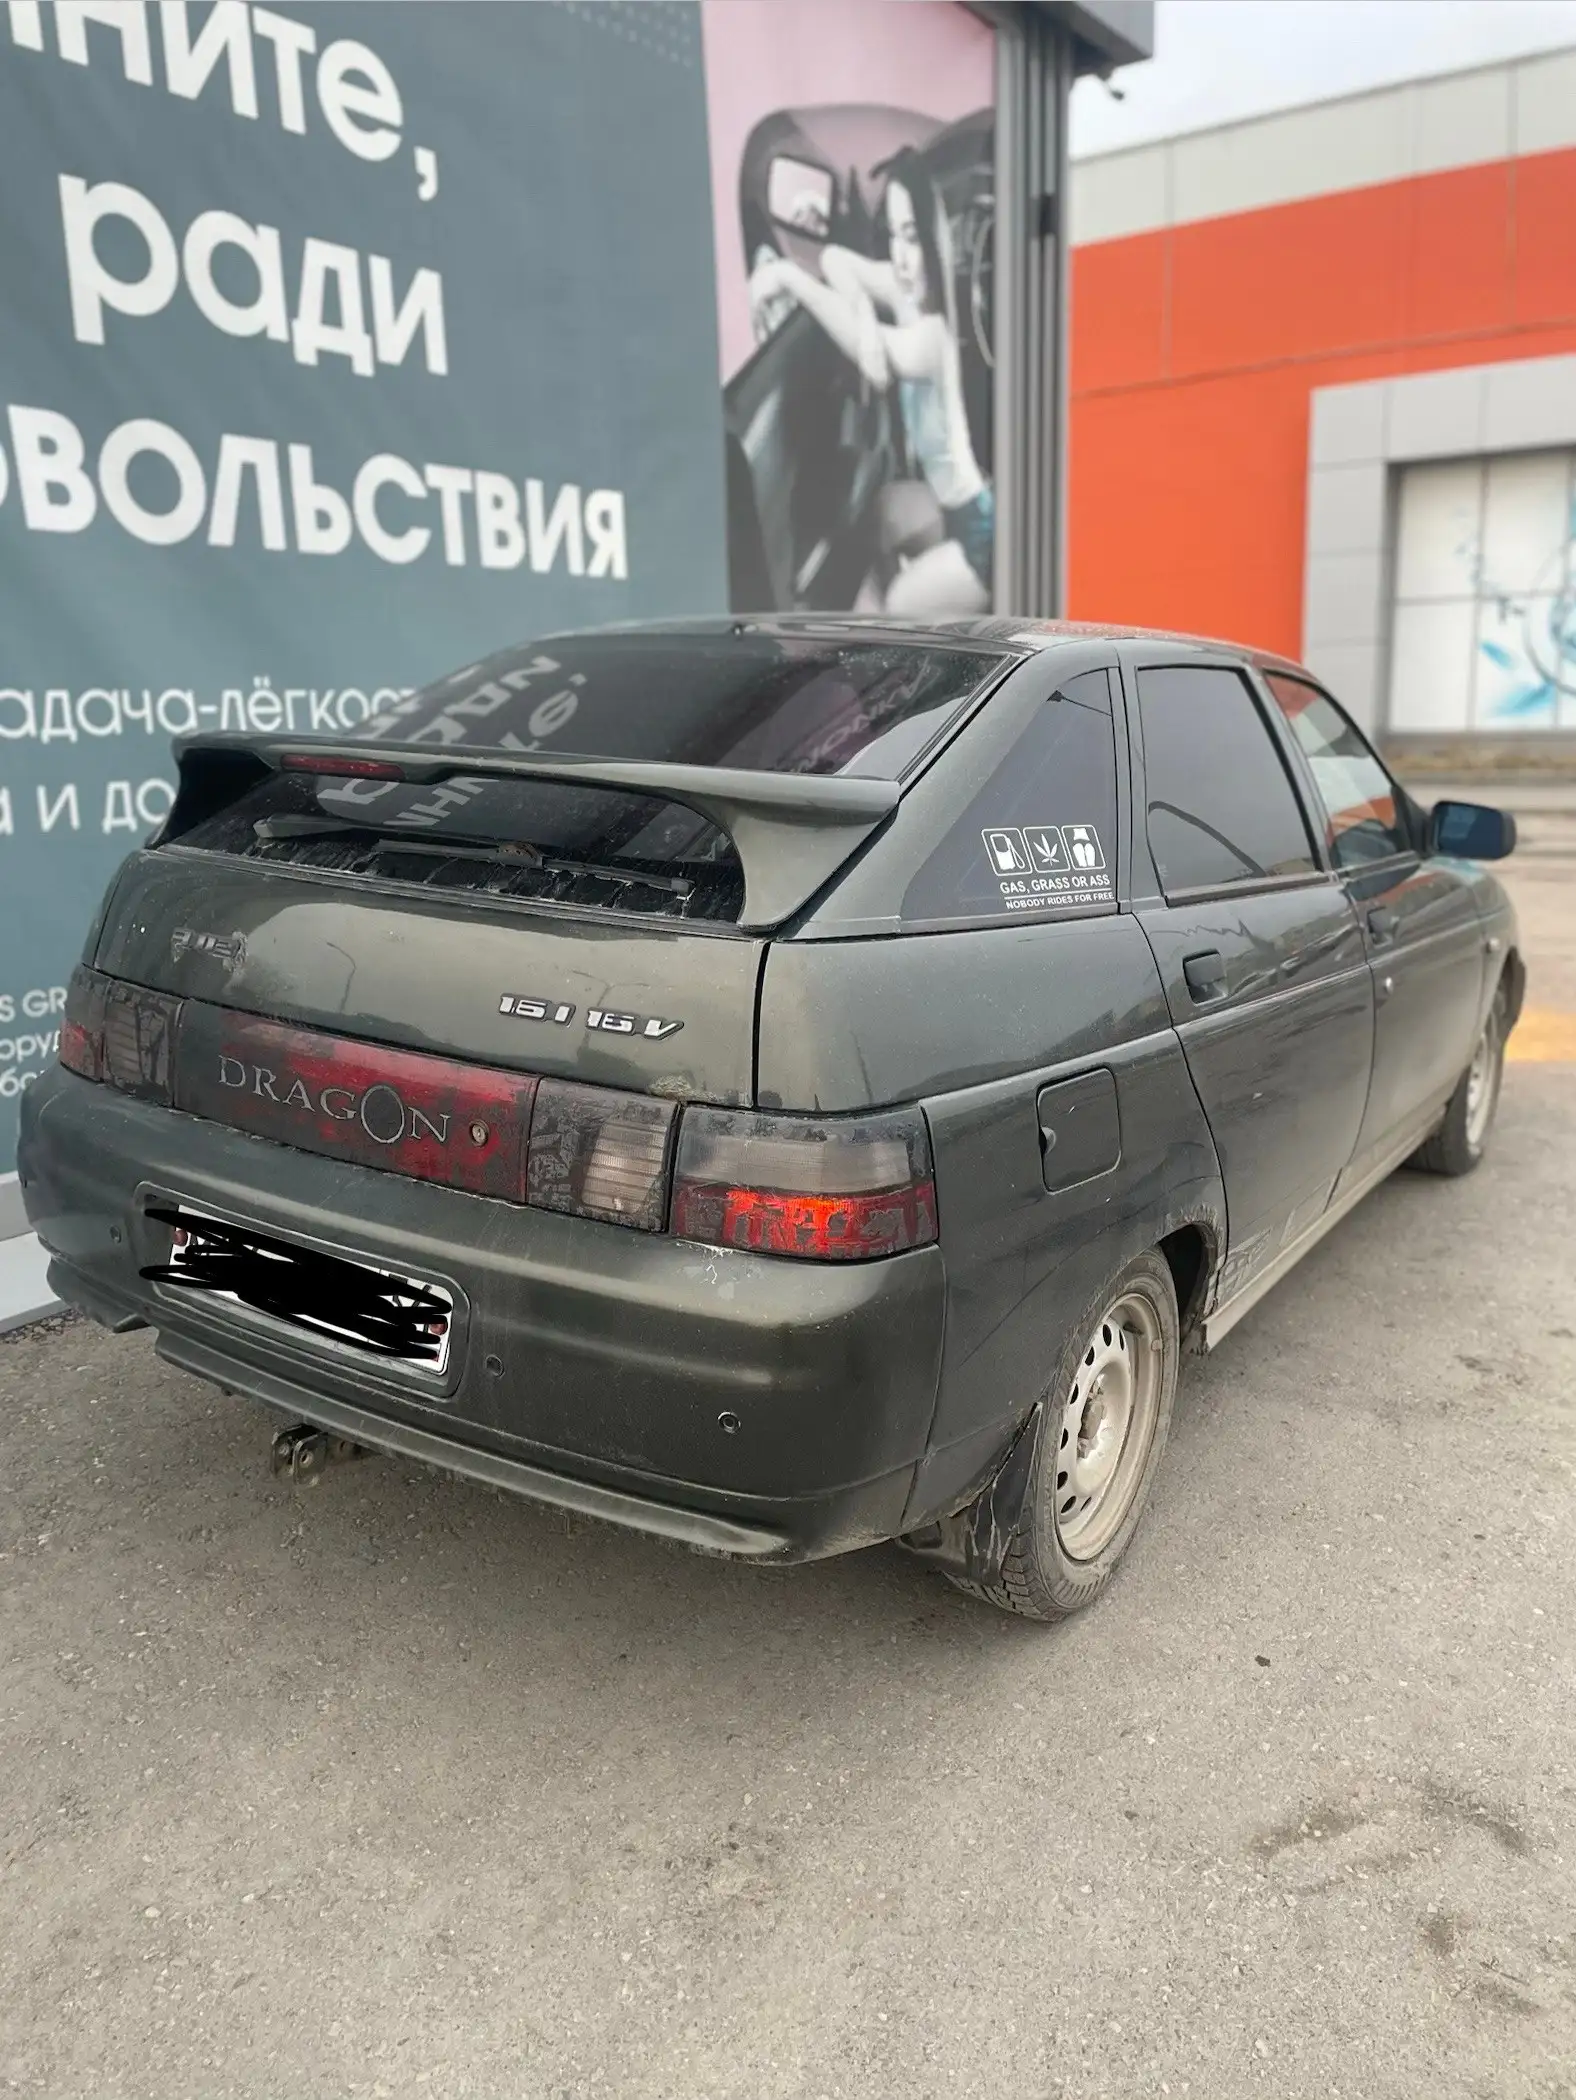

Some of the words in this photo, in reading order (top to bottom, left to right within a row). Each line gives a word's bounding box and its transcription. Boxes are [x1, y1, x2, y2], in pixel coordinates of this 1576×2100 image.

[58, 173, 448, 378] ради
[0, 403, 628, 579] вольствия
[36, 783, 81, 833] и
[1000, 879, 1031, 895] GAS,
[1031, 876, 1071, 892] GRASS
[1071, 875, 1090, 888] OR
[1090, 873, 1111, 886] ASS
[1005, 897, 1046, 910] NOBODY
[1047, 895, 1074, 906] RIDES
[1074, 893, 1093, 902] FOR
[1093, 891, 1115, 901] FREE
[218, 1055, 451, 1144] DRAGON
